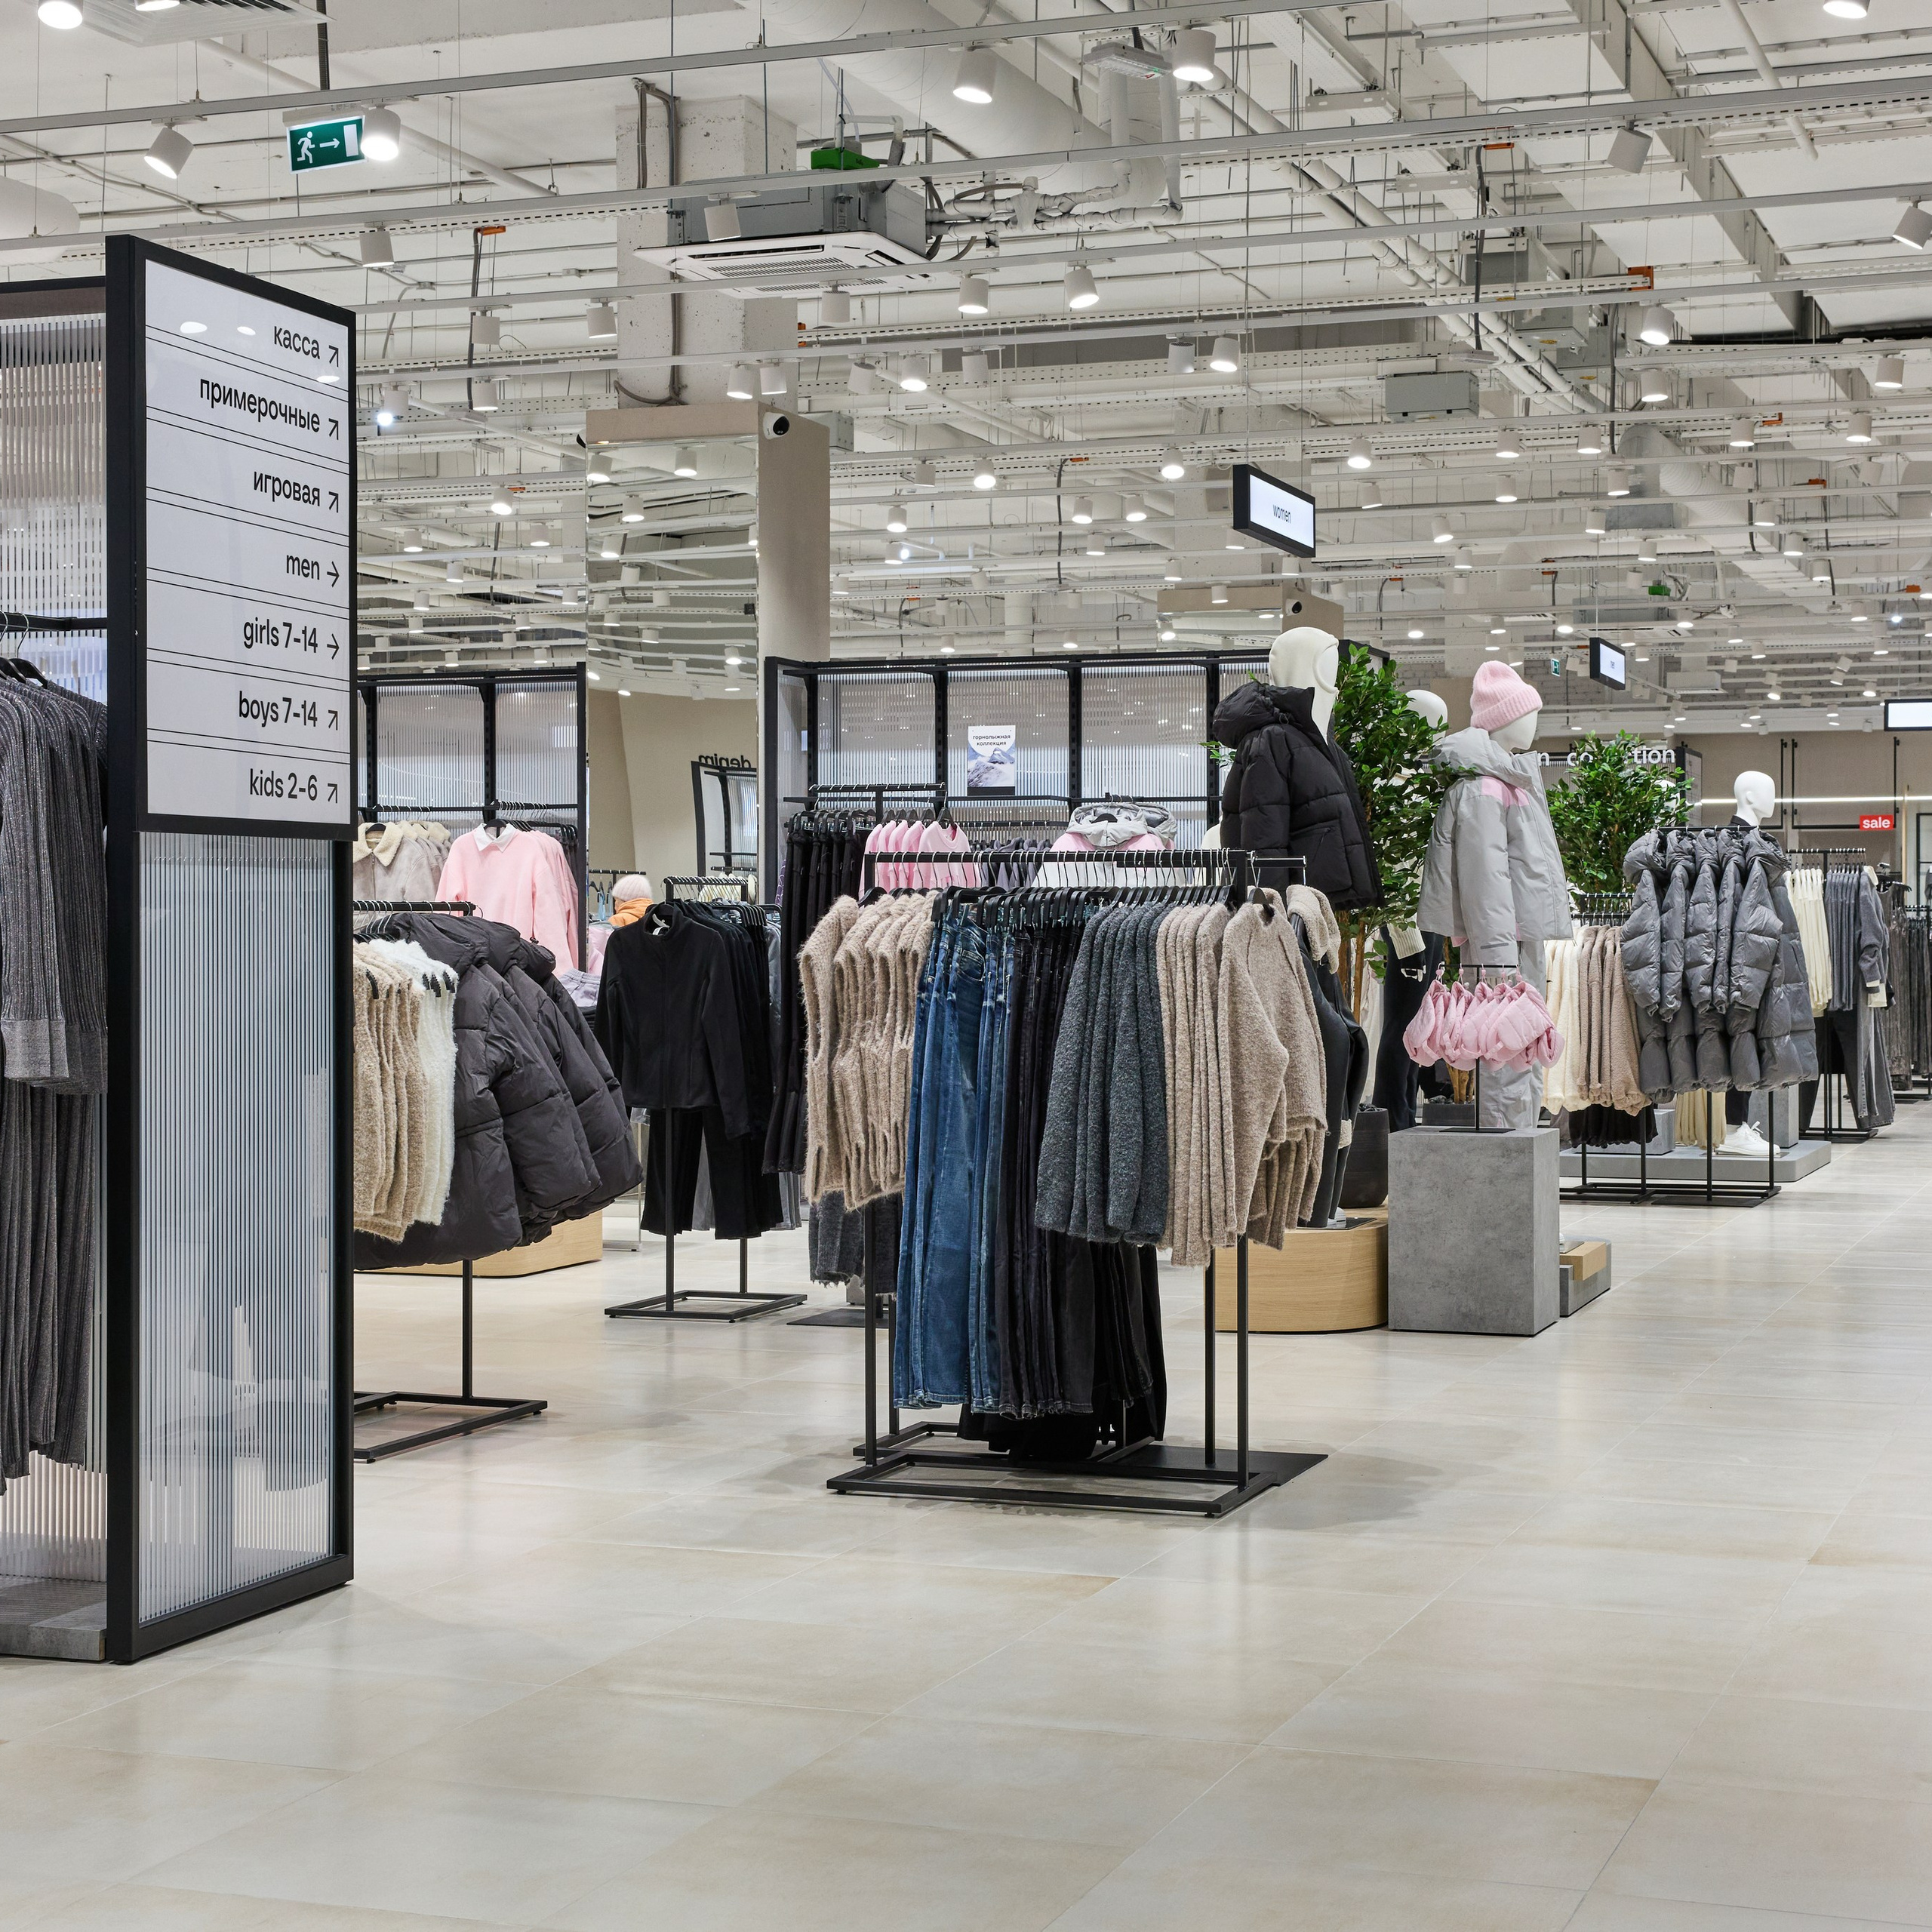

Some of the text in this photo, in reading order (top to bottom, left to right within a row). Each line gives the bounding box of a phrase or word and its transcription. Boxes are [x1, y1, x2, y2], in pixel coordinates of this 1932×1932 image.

[275, 325, 320, 360] касса
[200, 378, 320, 433] примерочные
[254, 471, 320, 507] игровая
[1272, 504, 1292, 524] women
[286, 555, 320, 580] men
[243, 617, 318, 654] girls 7-14
[238, 691, 318, 728] boys 7-14
[250, 768, 318, 801] kids 2-6
[1863, 817, 1890, 829] sale
